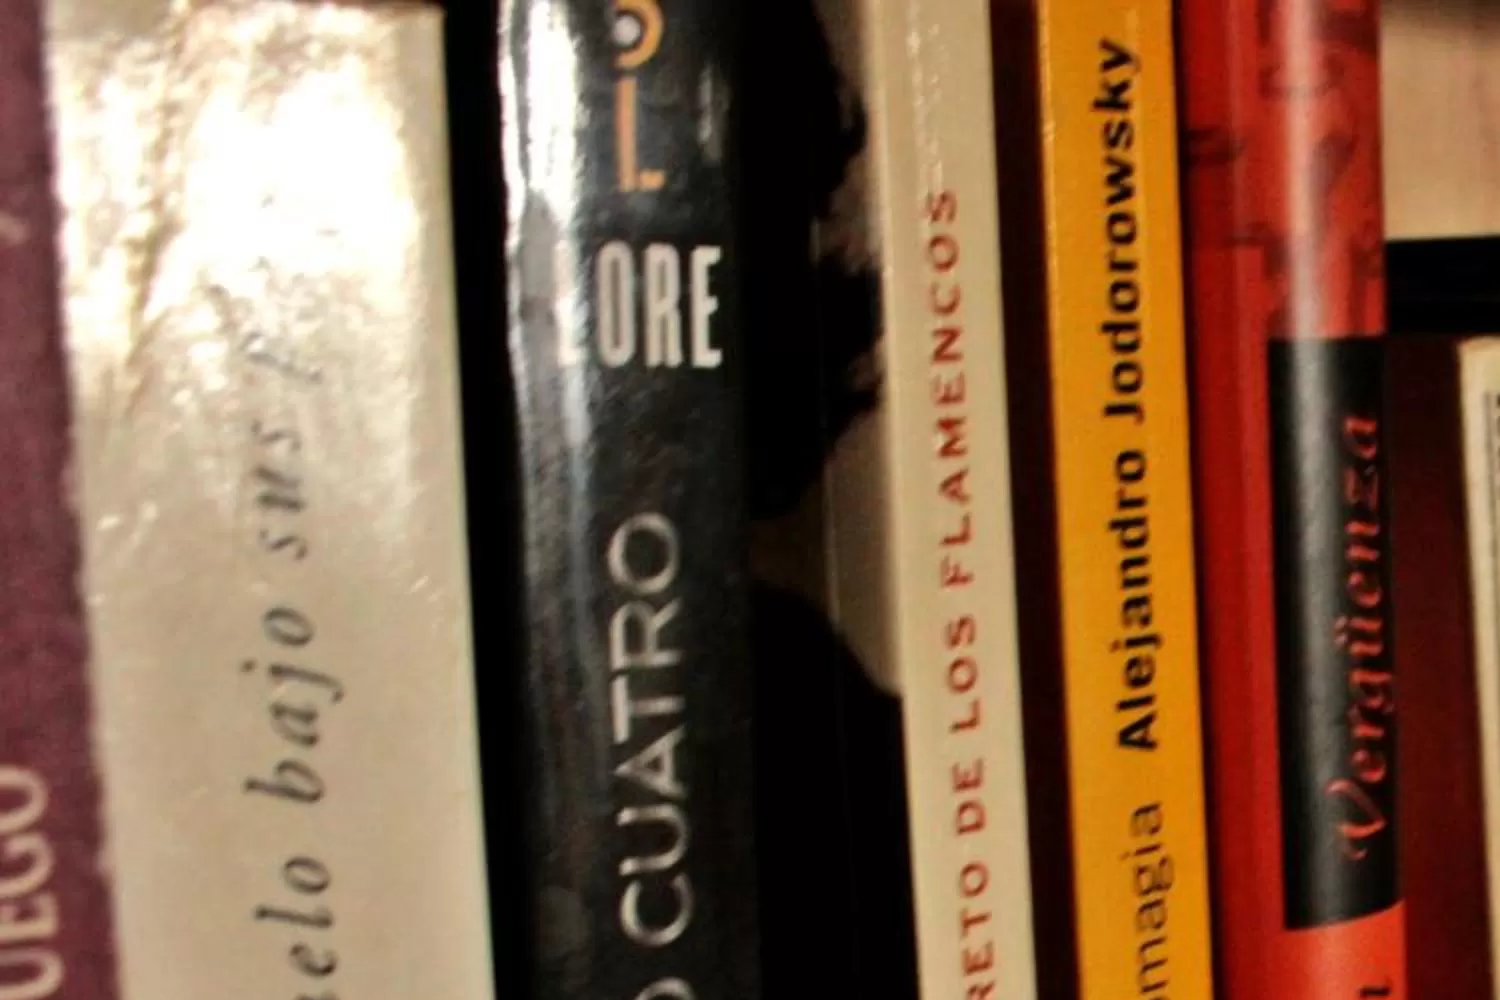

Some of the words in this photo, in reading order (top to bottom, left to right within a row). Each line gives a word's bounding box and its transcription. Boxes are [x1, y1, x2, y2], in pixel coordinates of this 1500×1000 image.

[1092, 38, 1142, 424] Jodorowsky
[923, 190, 975, 591] FLAMENCOS
[241, 606, 344, 805] bajo
[605, 511, 694, 947] CUATRO
[941, 616, 983, 734] LOS
[1107, 448, 1163, 752] Alejandro
[951, 758, 987, 836] DE
